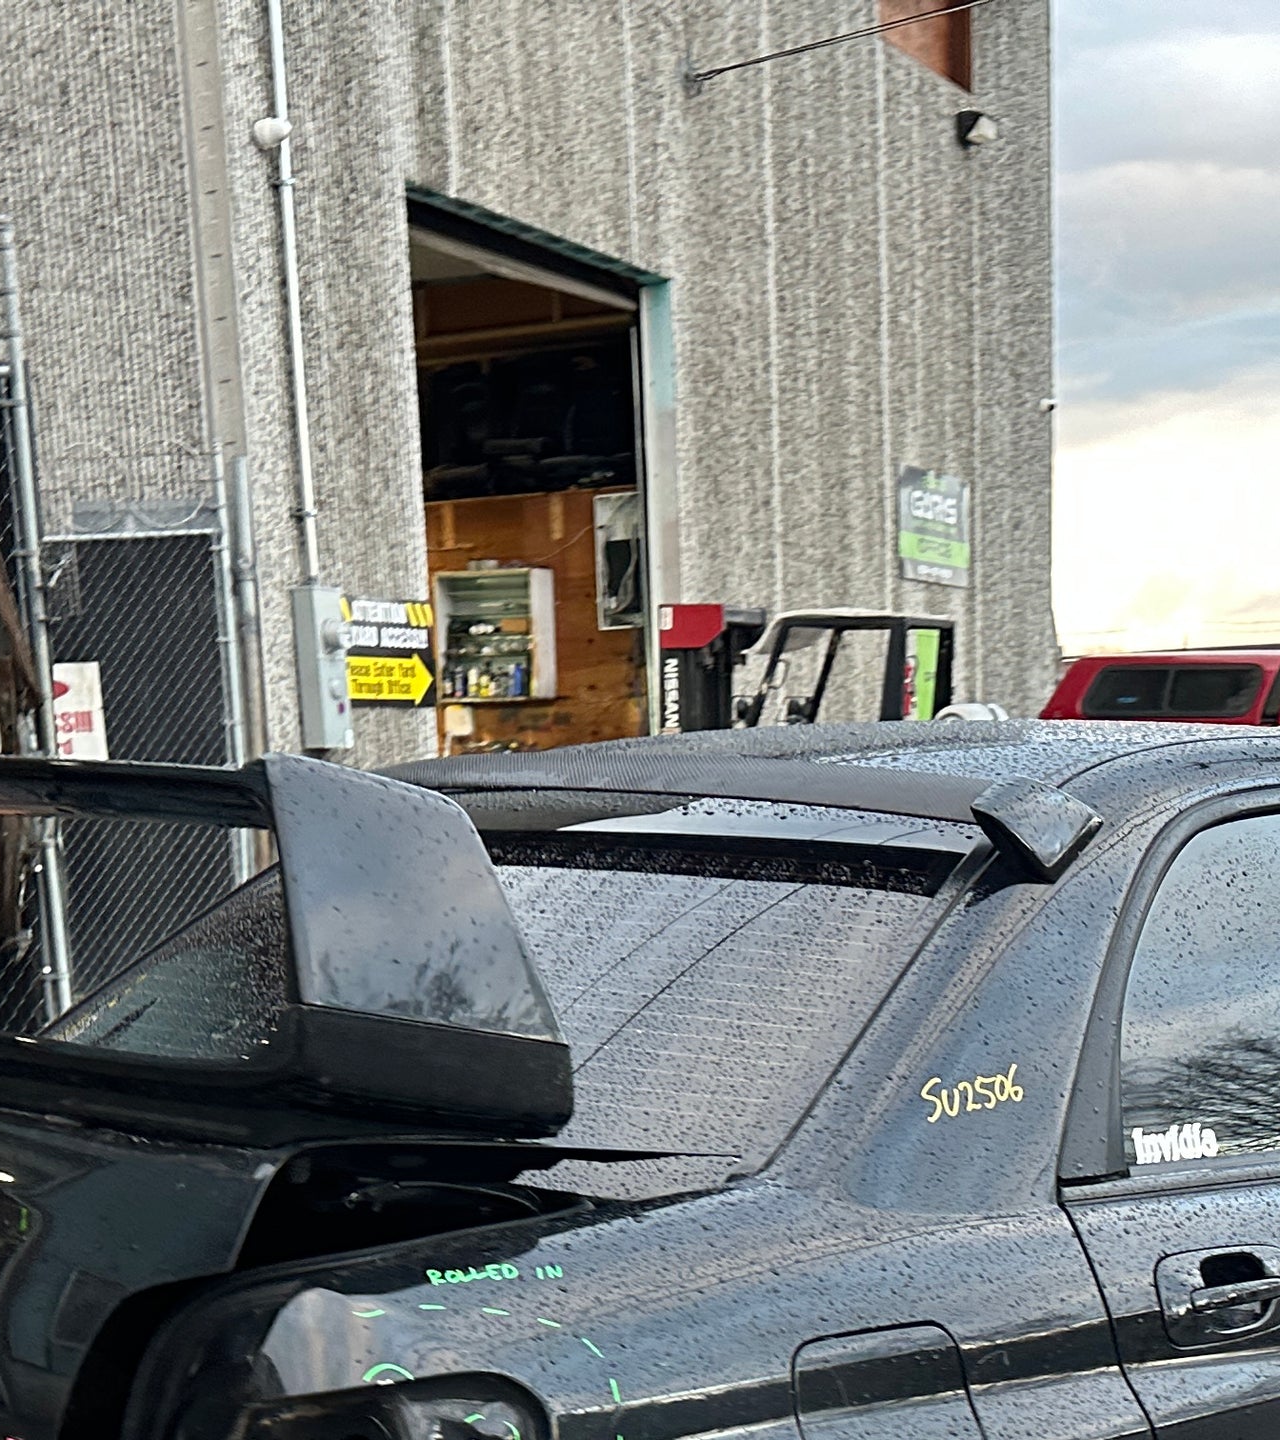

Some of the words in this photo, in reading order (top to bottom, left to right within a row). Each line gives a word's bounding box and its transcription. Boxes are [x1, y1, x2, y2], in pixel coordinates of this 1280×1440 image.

[664, 658, 680, 728] NISSAN
[921, 1064, 1024, 1123] SU2506
[426, 1263, 520, 1286] ROLLED
[536, 1264, 563, 1280] IN
